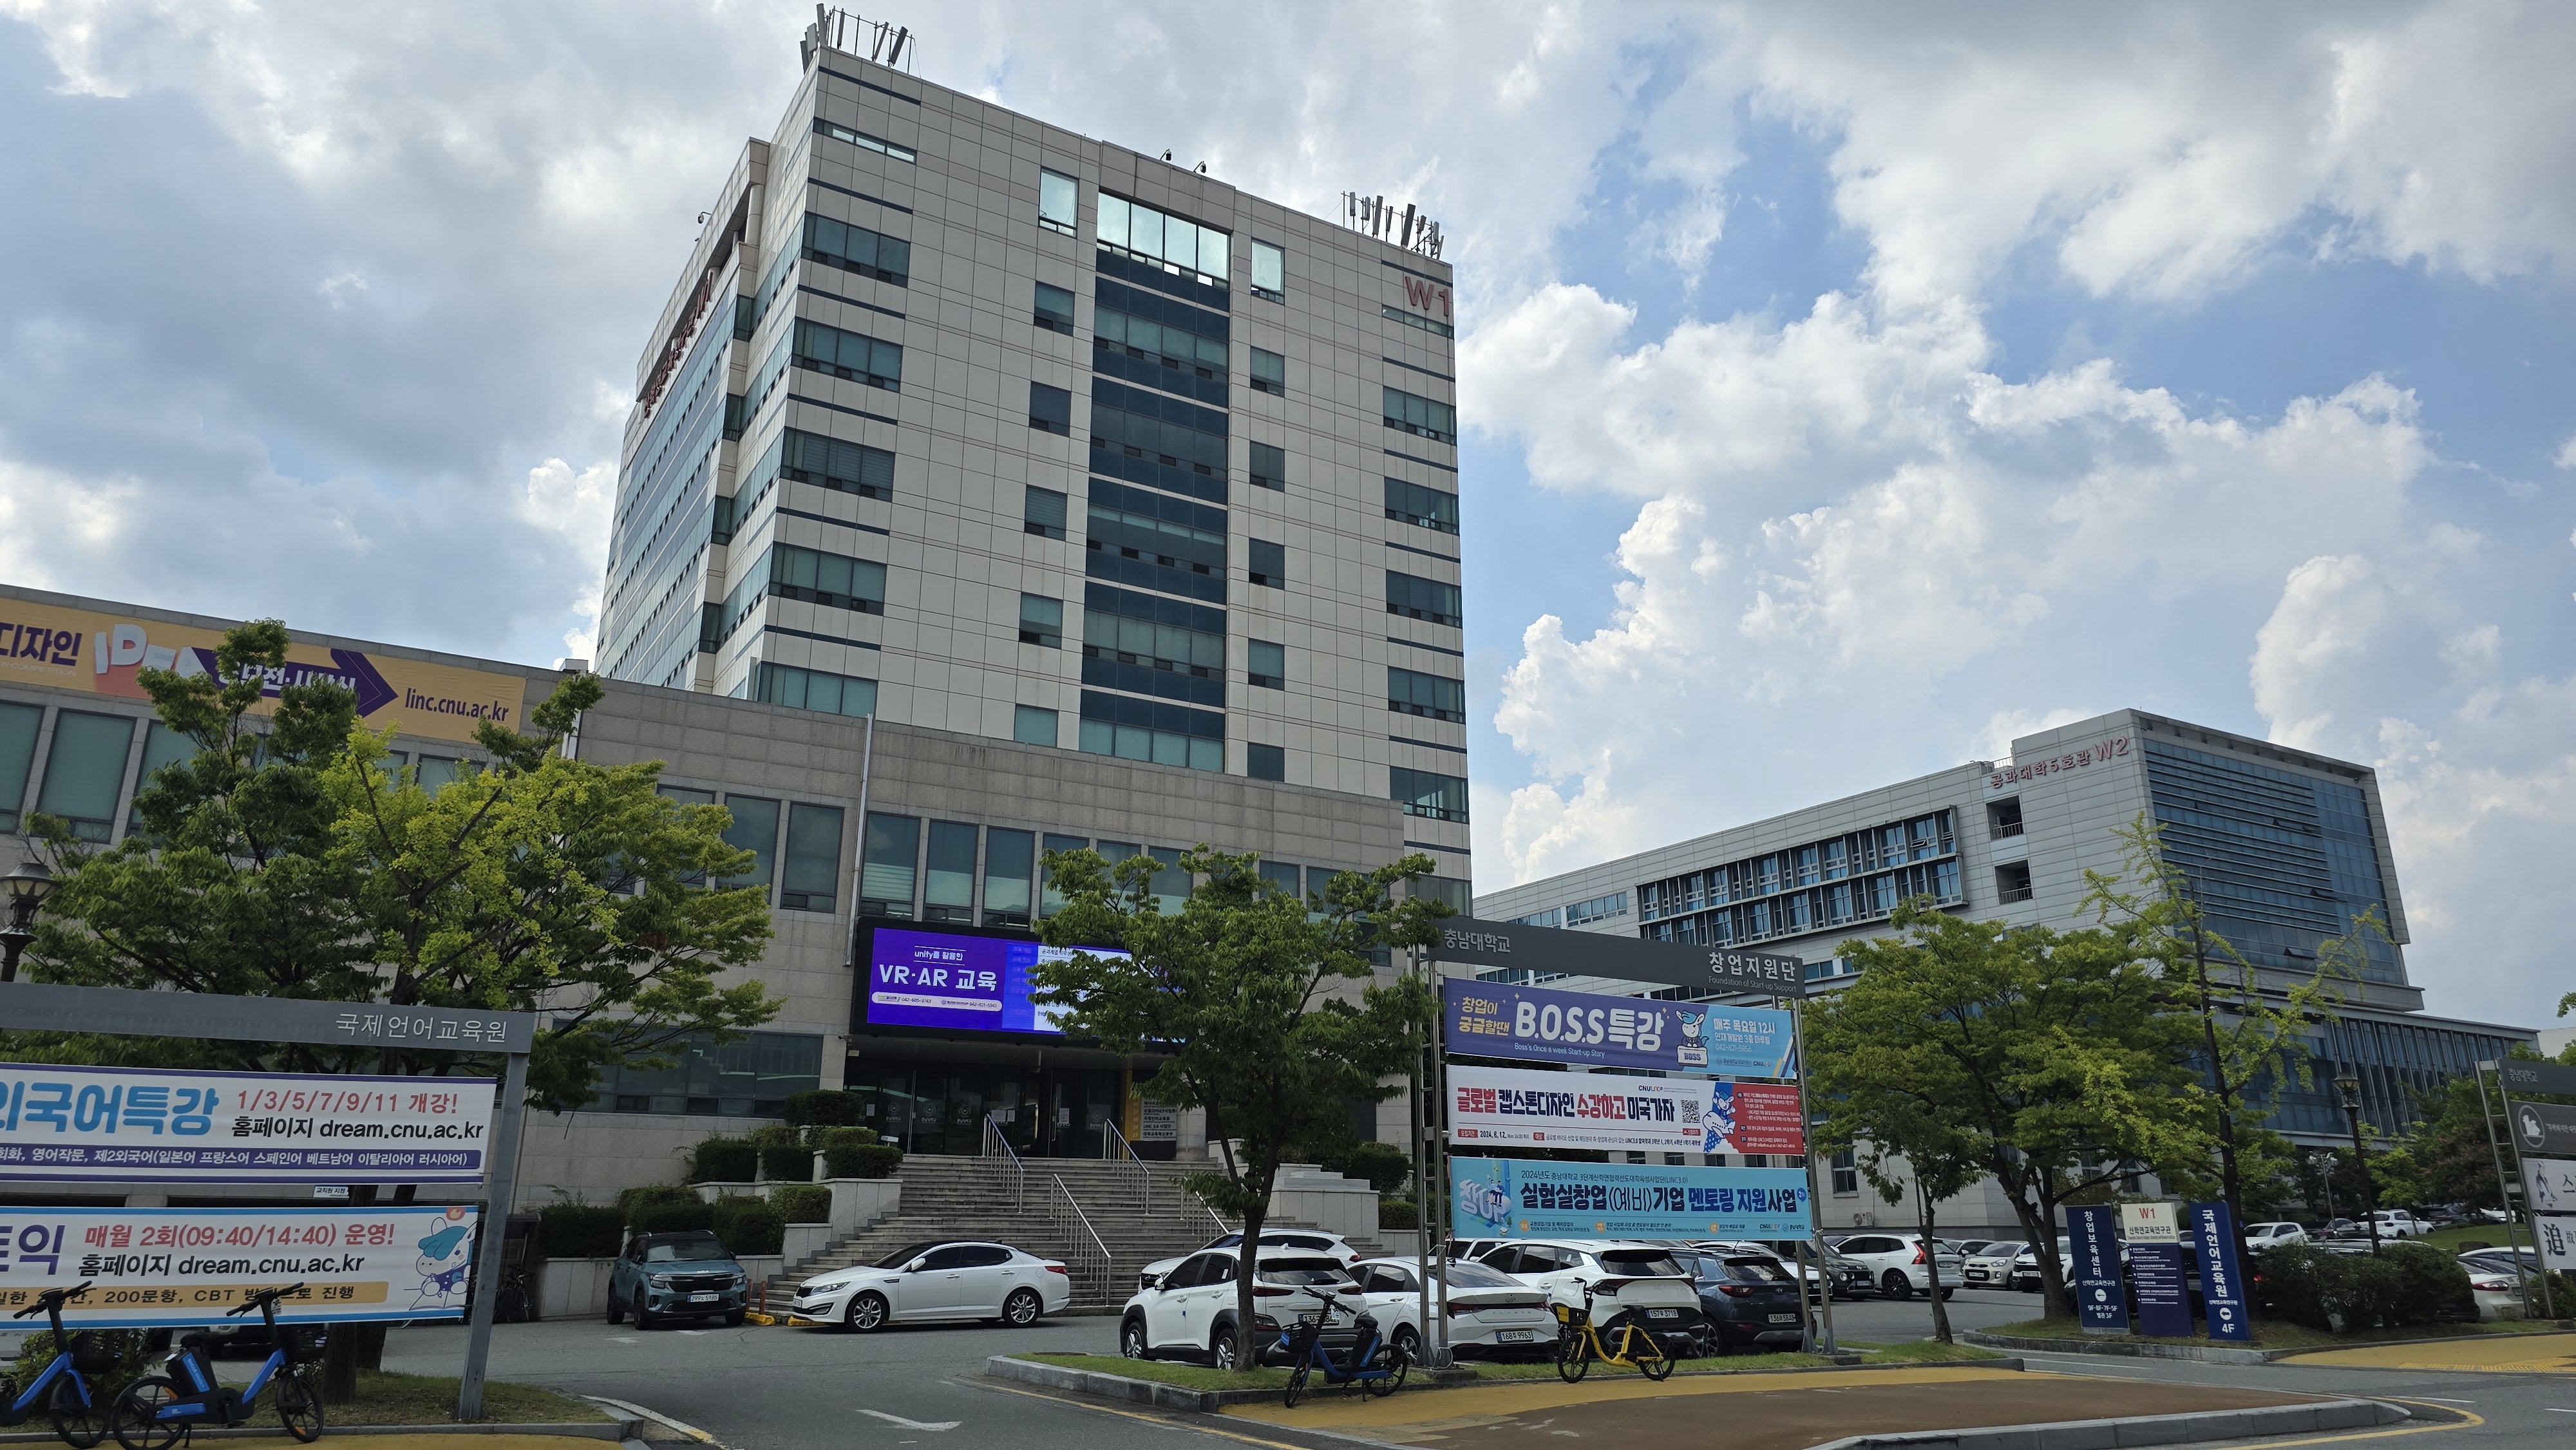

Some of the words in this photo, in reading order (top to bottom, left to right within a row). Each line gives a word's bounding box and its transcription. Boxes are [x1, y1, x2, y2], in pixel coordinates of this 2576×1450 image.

[1405, 276, 1449, 317] W1
[12, 662, 77, 676] COMPETITION
[406, 688, 509, 721] linc.cnu.ac.kr
[2094, 737, 2129, 760] W2
[1444, 928, 1511, 953] 충남대학교
[1708, 952, 1795, 982] 창업지원단
[956, 968, 997, 992] 교육
[1708, 975, 1742, 987] Foundation
[1750, 980, 1773, 991] Start-up
[1774, 983, 1797, 993] Support
[1462, 997, 1498, 1015] 창업이
[336, 1013, 507, 1043] 국제언어교육원
[1459, 1016, 1510, 1036] 궁금할땐
[1713, 1018, 1731, 1031] 매주
[1733, 1019, 1757, 1033] 목요일
[1758, 1022, 1776, 1034] 12시
[1744, 1034, 1754, 1044] 3층
[1533, 1044, 1547, 1052] Once
[1553, 1046, 1567, 1054] week
[1568, 1048, 1591, 1058] Start-up
[1591, 1048, 1605, 1059] Story
[1683, 1052, 1701, 1061] BOSS
[2508, 1068, 2538, 1083] 충남대학교
[238, 1089, 398, 1113] 1/3/5/7/9/11
[408, 1093, 458, 1114] 개강!
[1457, 1087, 1497, 1114] 글로벌
[1498, 1089, 1575, 1118] 캡스톤디자인
[1577, 1093, 1626, 1120] 수강하고
[1627, 1096, 1674, 1122] 미국가자
[231, 1116, 314, 1138] 홈페이지
[319, 1119, 484, 1140] dream.cnu.ac.kr
[33, 1148, 88, 1163] 영어작문,
[94, 1149, 196, 1165] 제2외국어(일본어
[200, 1151, 249, 1165] 프랑스어
[254, 1153, 302, 1165] 스페인어
[307, 1153, 354, 1165] 베트남어
[359, 1153, 414, 1166] 이탈리아어
[419, 1153, 468, 1166] 러시아어)
[1522, 1169, 1550, 1180] 2024년도
[1551, 1172, 1578, 1181] 충남대학교
[1689, 1187, 1734, 1213] 멘토링
[2139, 1207, 2155, 1219] W1
[85, 1224, 133, 1248] 매월
[139, 1223, 336, 1248] 2회(09:40/14:40)
[345, 1223, 395, 1245] 운영!
[2129, 1226, 2171, 1235] 산학연교육연구관
[2544, 1223, 2566, 1256] 追
[2084, 1210, 2102, 1277] 창업보육센터
[2202, 1209, 2228, 1297] 국제언어교육원
[78, 1254, 172, 1277] 홈페이지
[178, 1253, 365, 1275] dream.cnu.ac.kr
[104, 1290, 183, 1304] 200문항,
[194, 1289, 235, 1301] CBT
[323, 1286, 354, 1299] 진행
[2222, 1324, 2235, 1333] 4F
